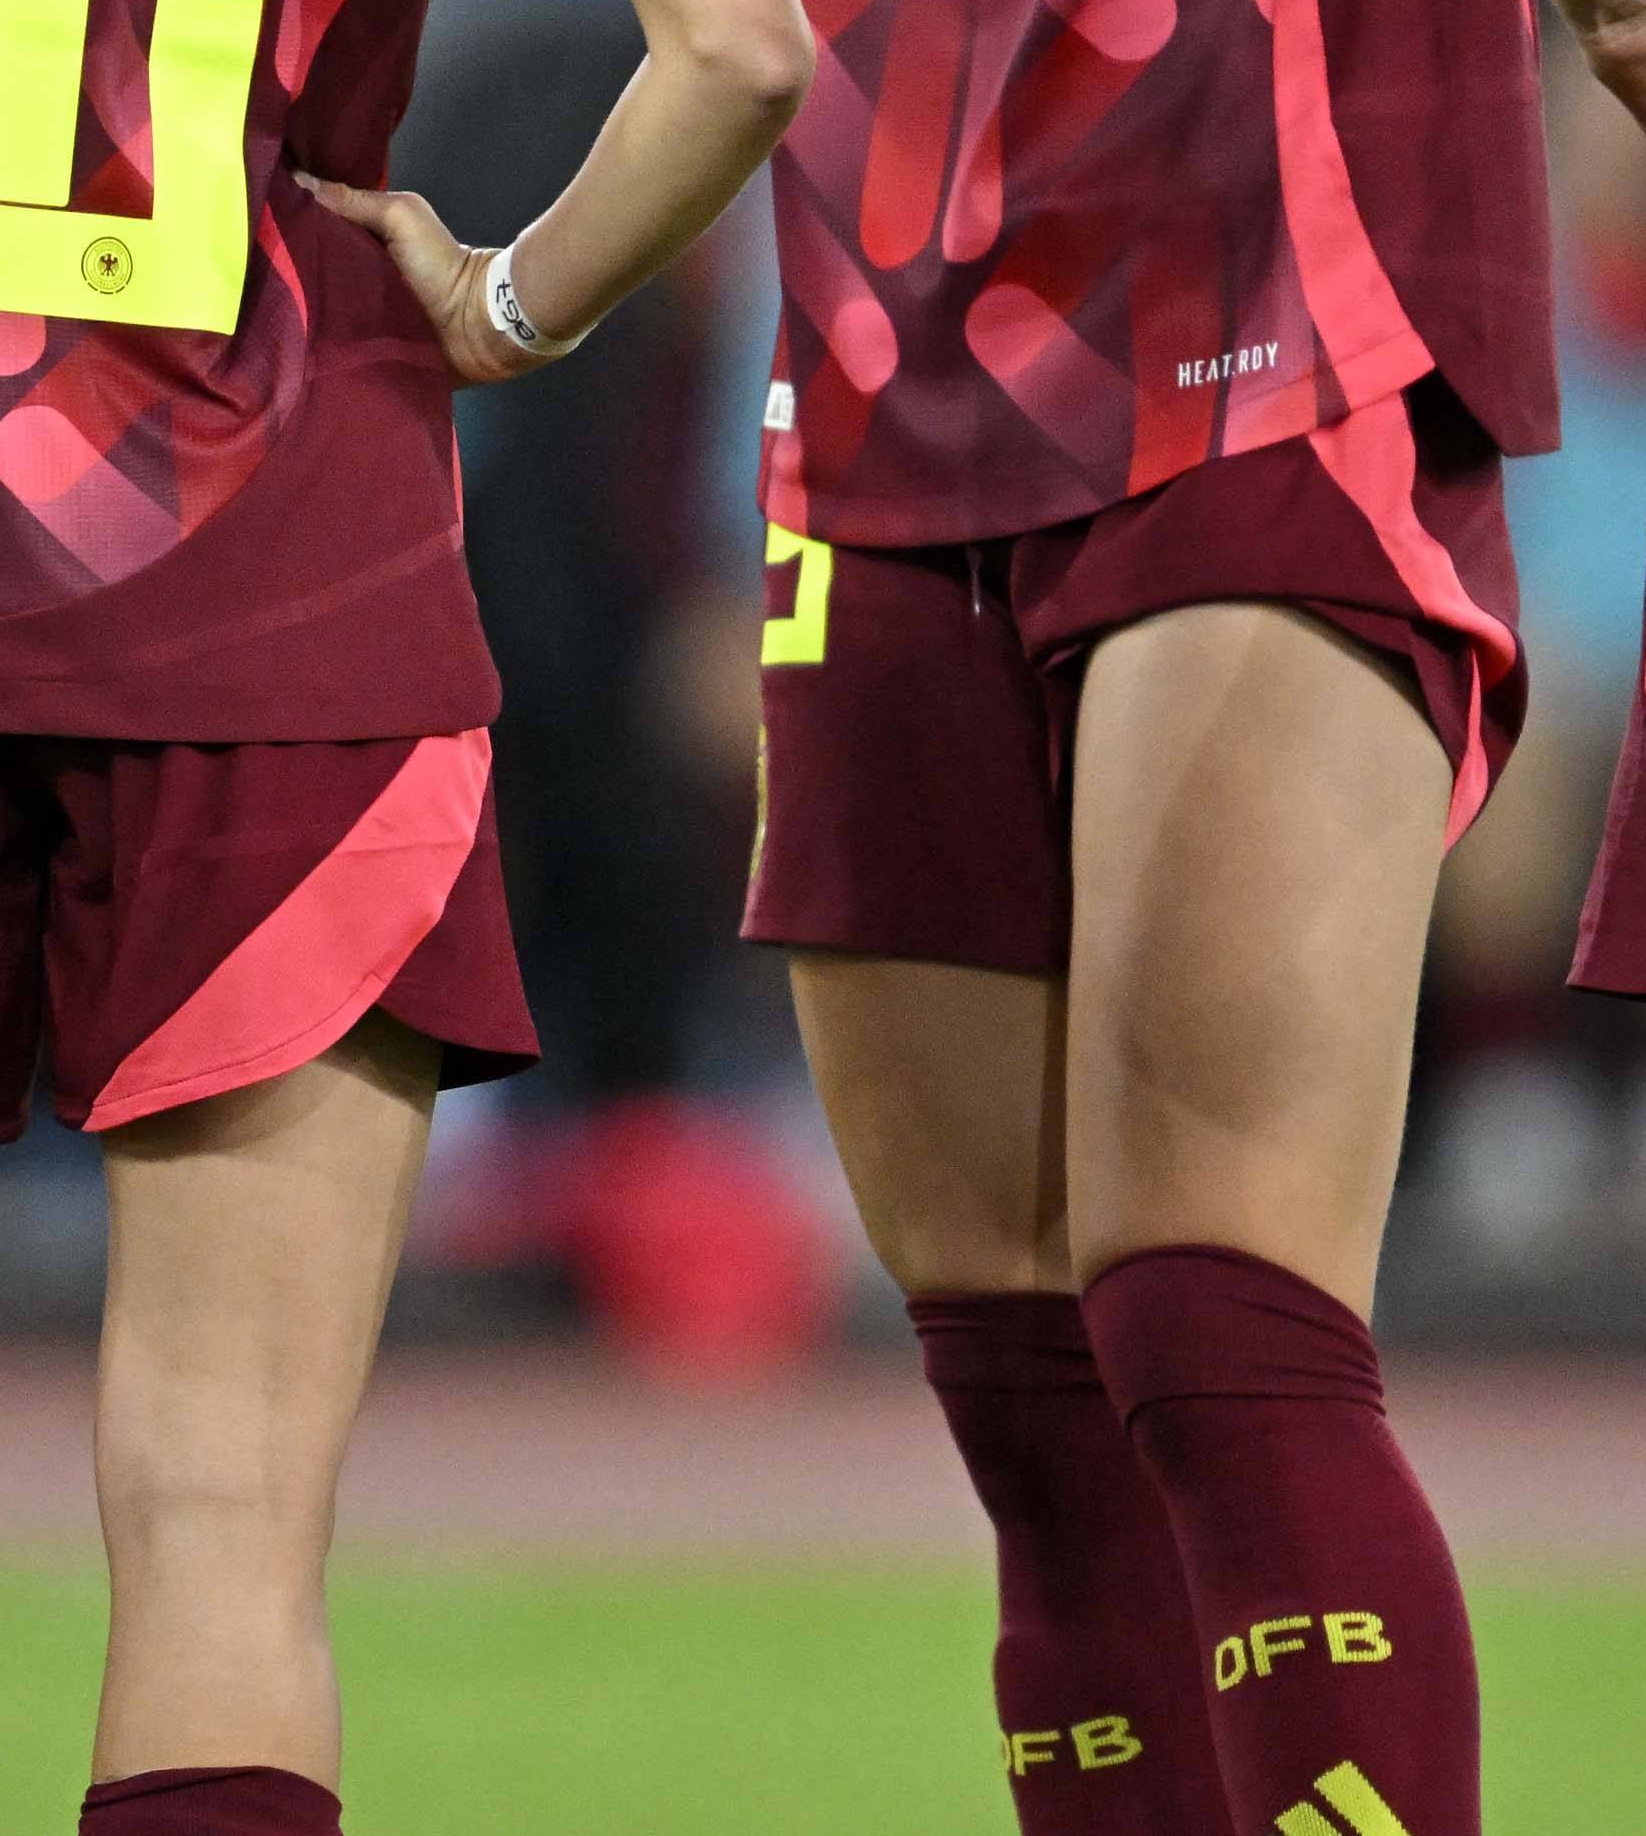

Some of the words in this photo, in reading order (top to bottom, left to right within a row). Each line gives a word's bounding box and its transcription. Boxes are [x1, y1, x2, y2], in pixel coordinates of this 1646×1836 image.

[1177, 342, 1279, 389] HEAT.RDY
[1214, 1611, 1393, 1692] DFB
[1001, 1714, 1144, 1776] FB
